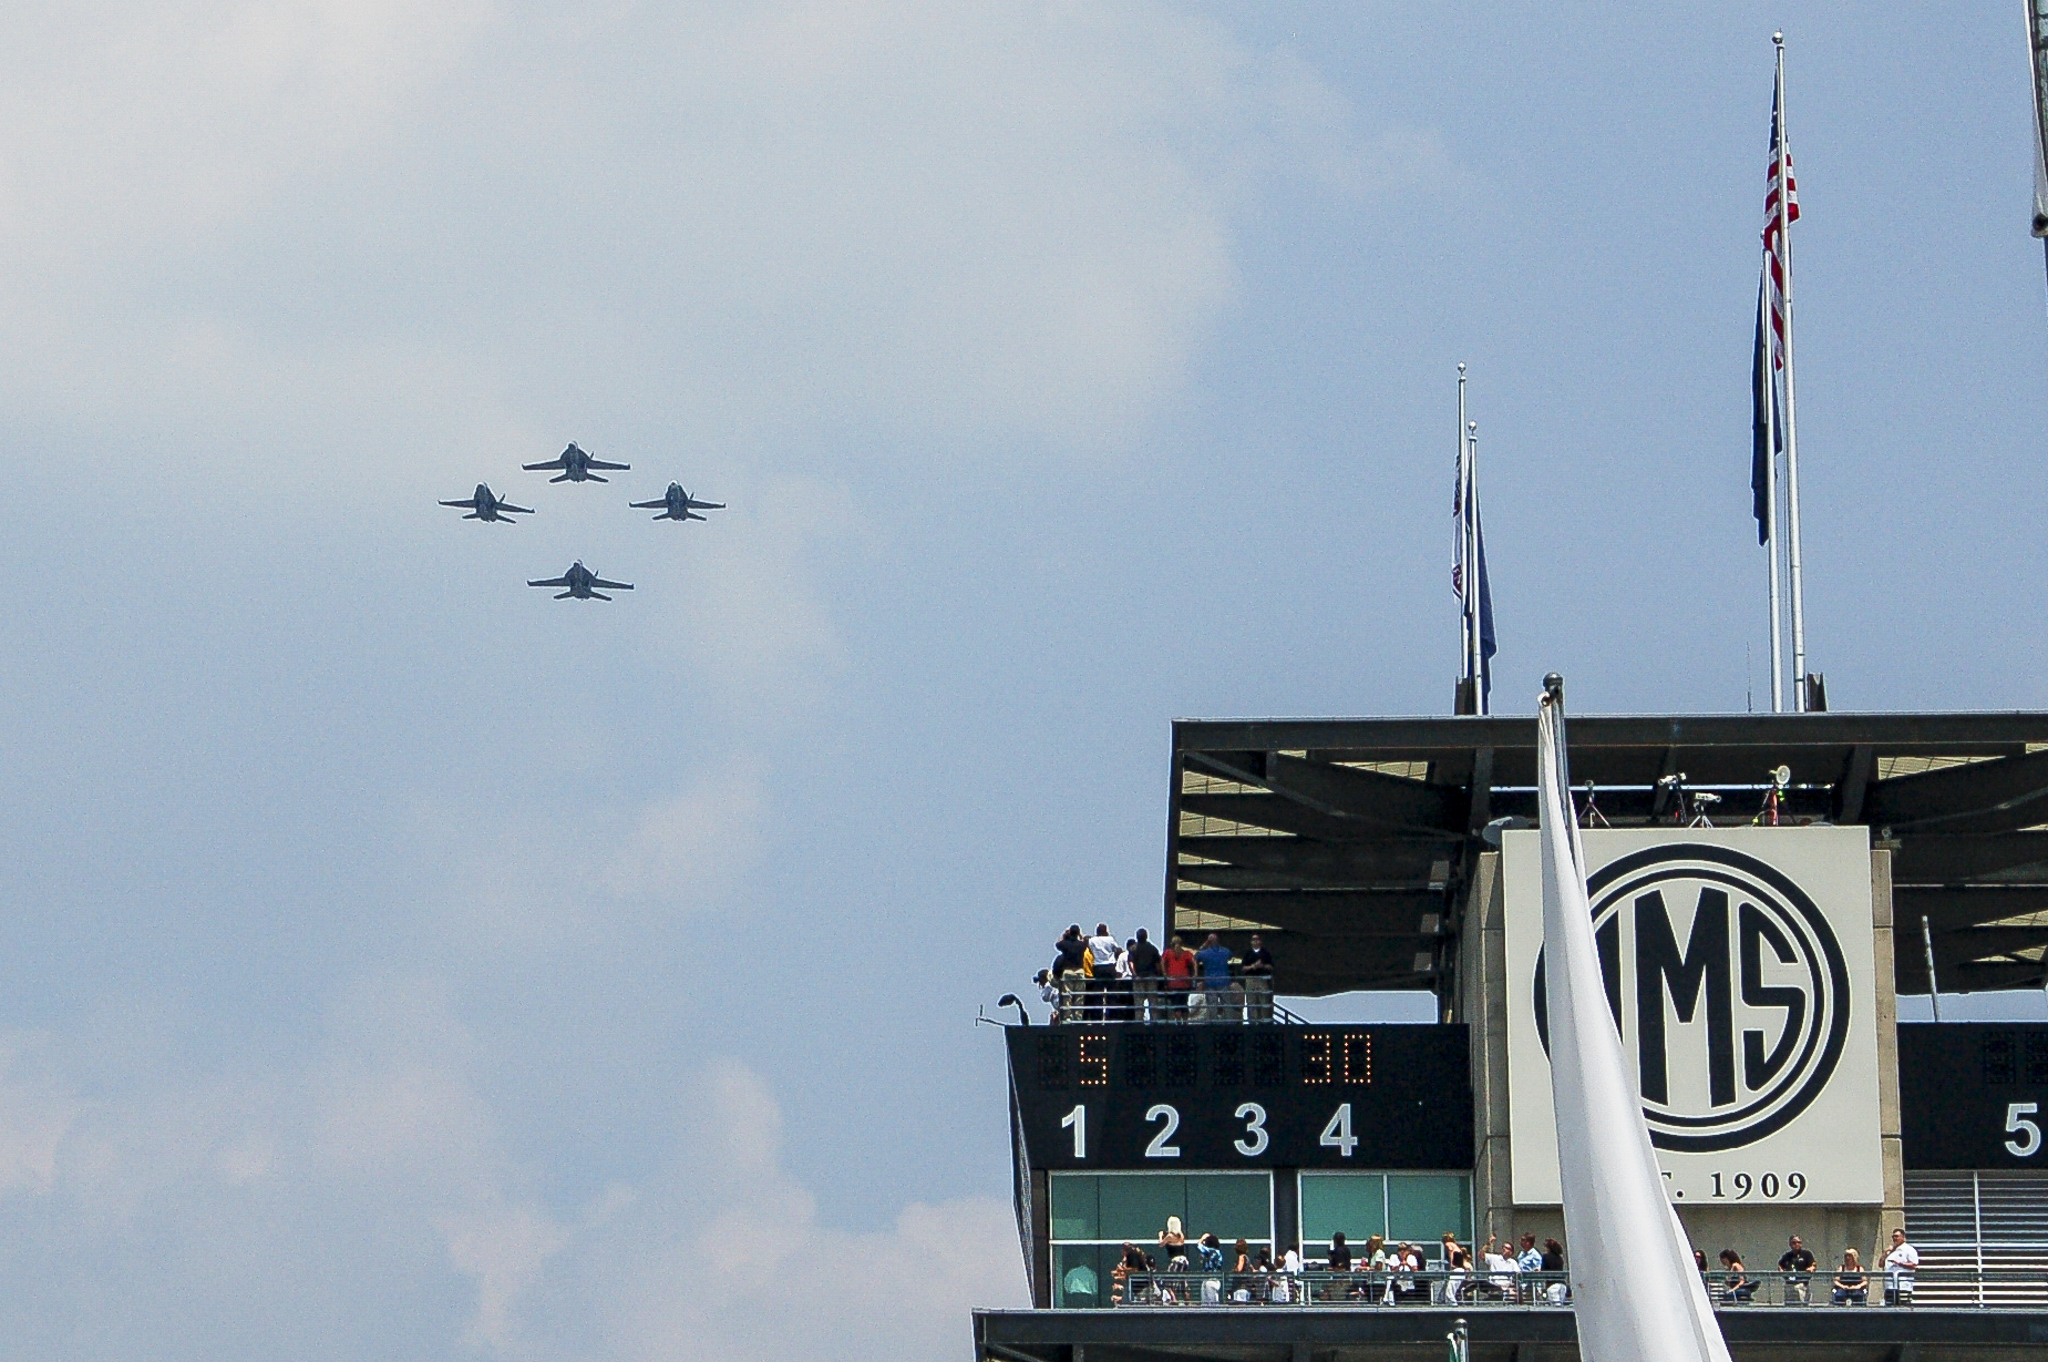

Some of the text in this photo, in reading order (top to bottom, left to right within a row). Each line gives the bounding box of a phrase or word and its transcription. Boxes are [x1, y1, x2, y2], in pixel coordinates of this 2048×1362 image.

[1079, 1034, 1372, 1086] 5 30
[1061, 1102, 1359, 1159] 1 2 3 4
[2004, 1101, 2042, 1157] 5
[1711, 1172, 1807, 1200] 1909
